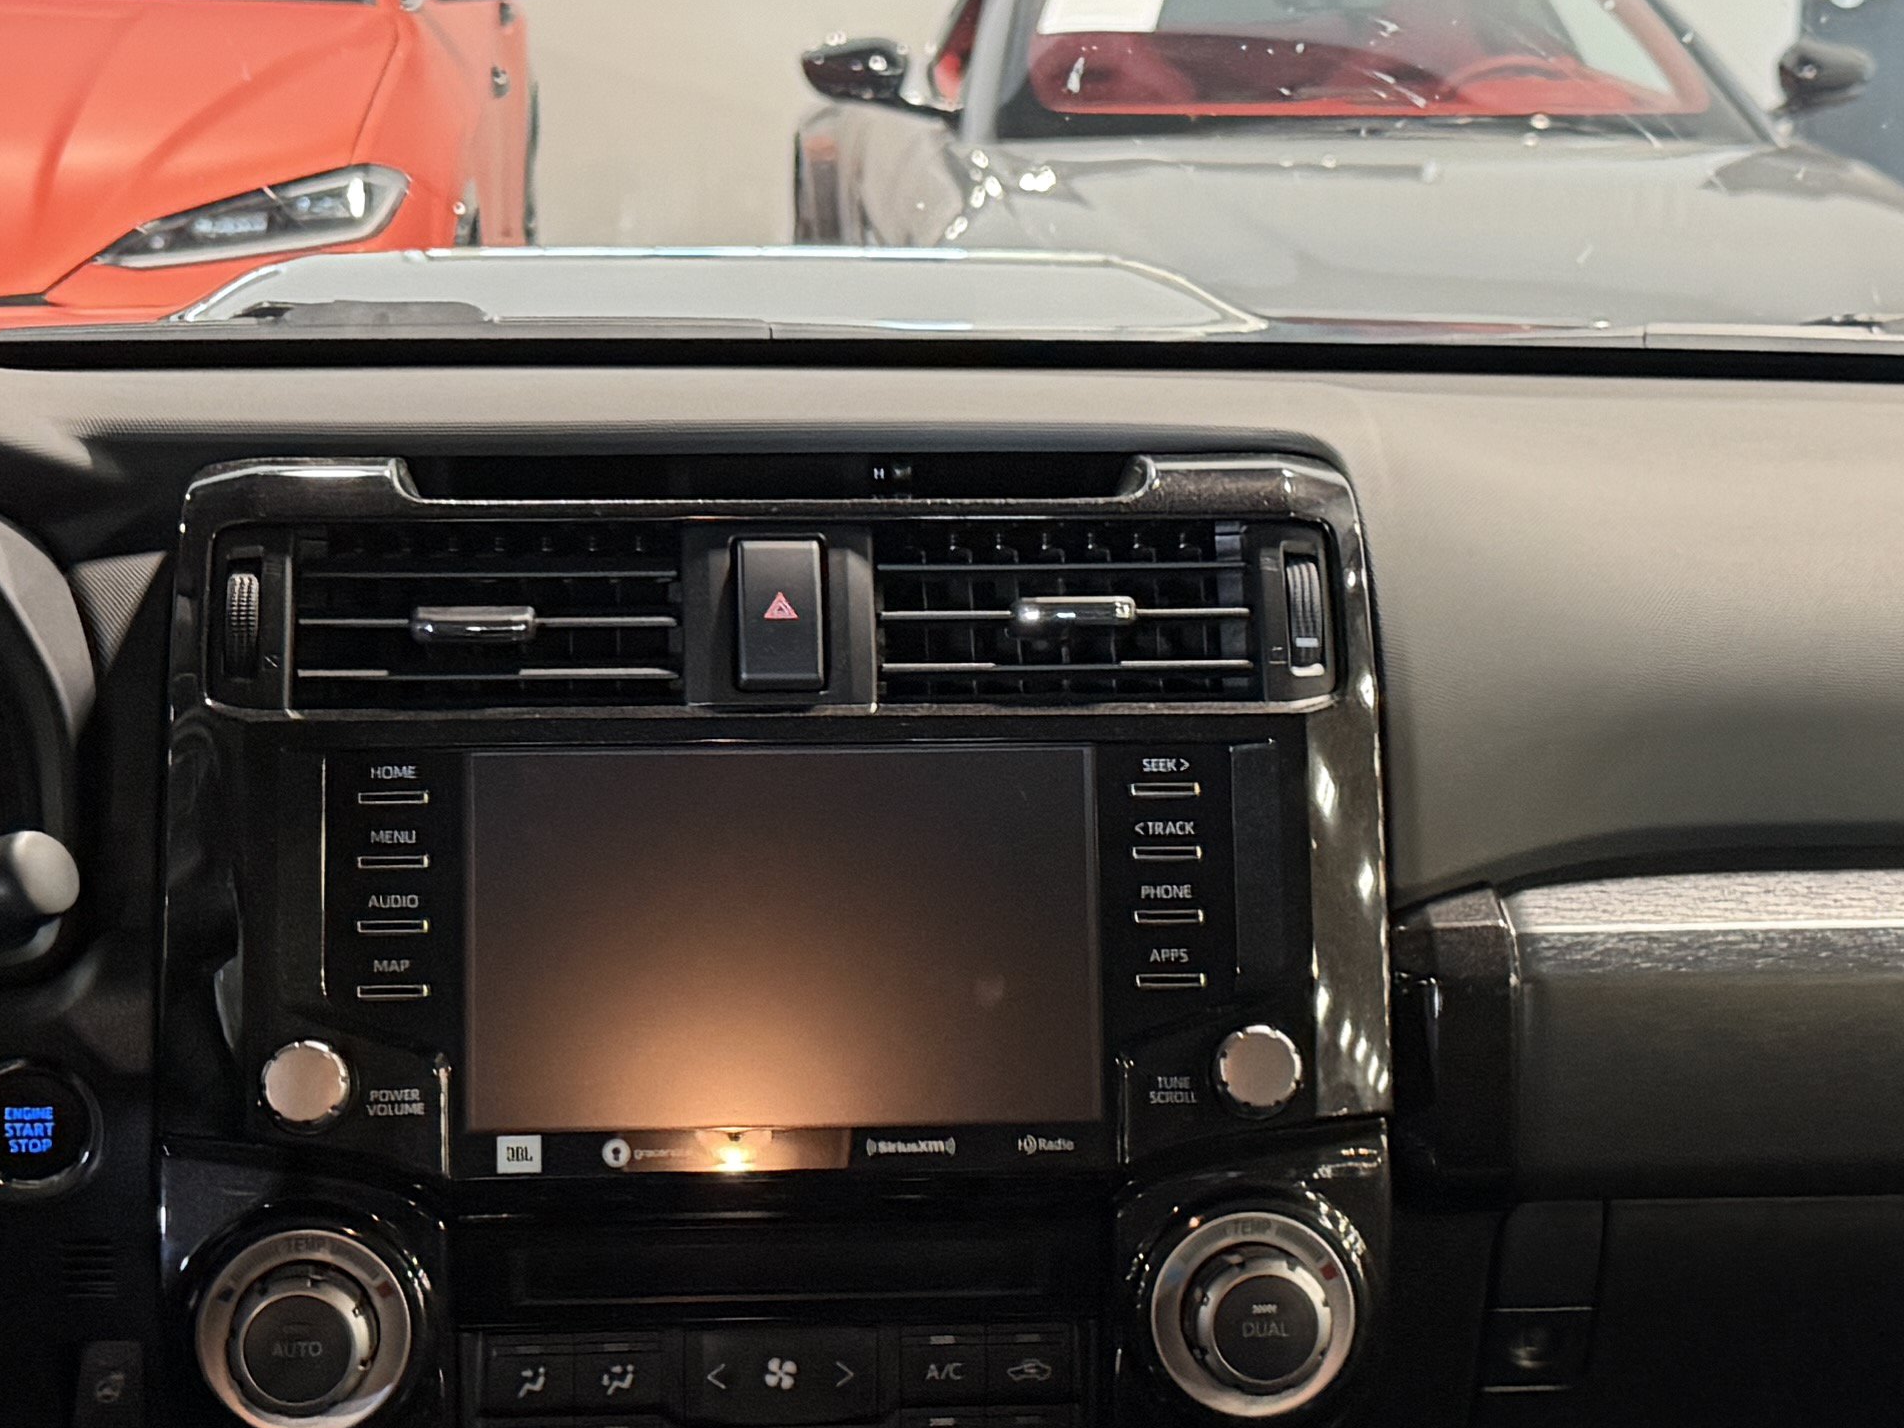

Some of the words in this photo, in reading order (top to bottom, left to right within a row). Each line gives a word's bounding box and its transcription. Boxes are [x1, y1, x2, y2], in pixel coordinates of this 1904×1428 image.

[370, 766, 418, 780] HOME
[1142, 758, 1177, 773] SEEK
[1146, 821, 1196, 836] TRACK
[370, 830, 417, 844] MENU
[1140, 884, 1193, 899] PHONE
[368, 894, 420, 909] AUDIO
[1149, 948, 1190, 963] APPS
[373, 959, 411, 973] MAP
[1157, 1075, 1191, 1090] TUNE
[369, 1088, 421, 1102] POWER
[1149, 1090, 1198, 1105] SCROLL
[3, 1106, 54, 1121] ENGINE
[365, 1102, 426, 1117] VOLUME
[3, 1122, 56, 1138] START
[7, 1138, 54, 1154] STOP
[1037, 1137, 1076, 1152] Radio
[505, 1146, 534, 1163] JBL
[1241, 1321, 1290, 1338] DUAL
[271, 1340, 323, 1358] AUTO
[926, 1362, 965, 1381] A/C
